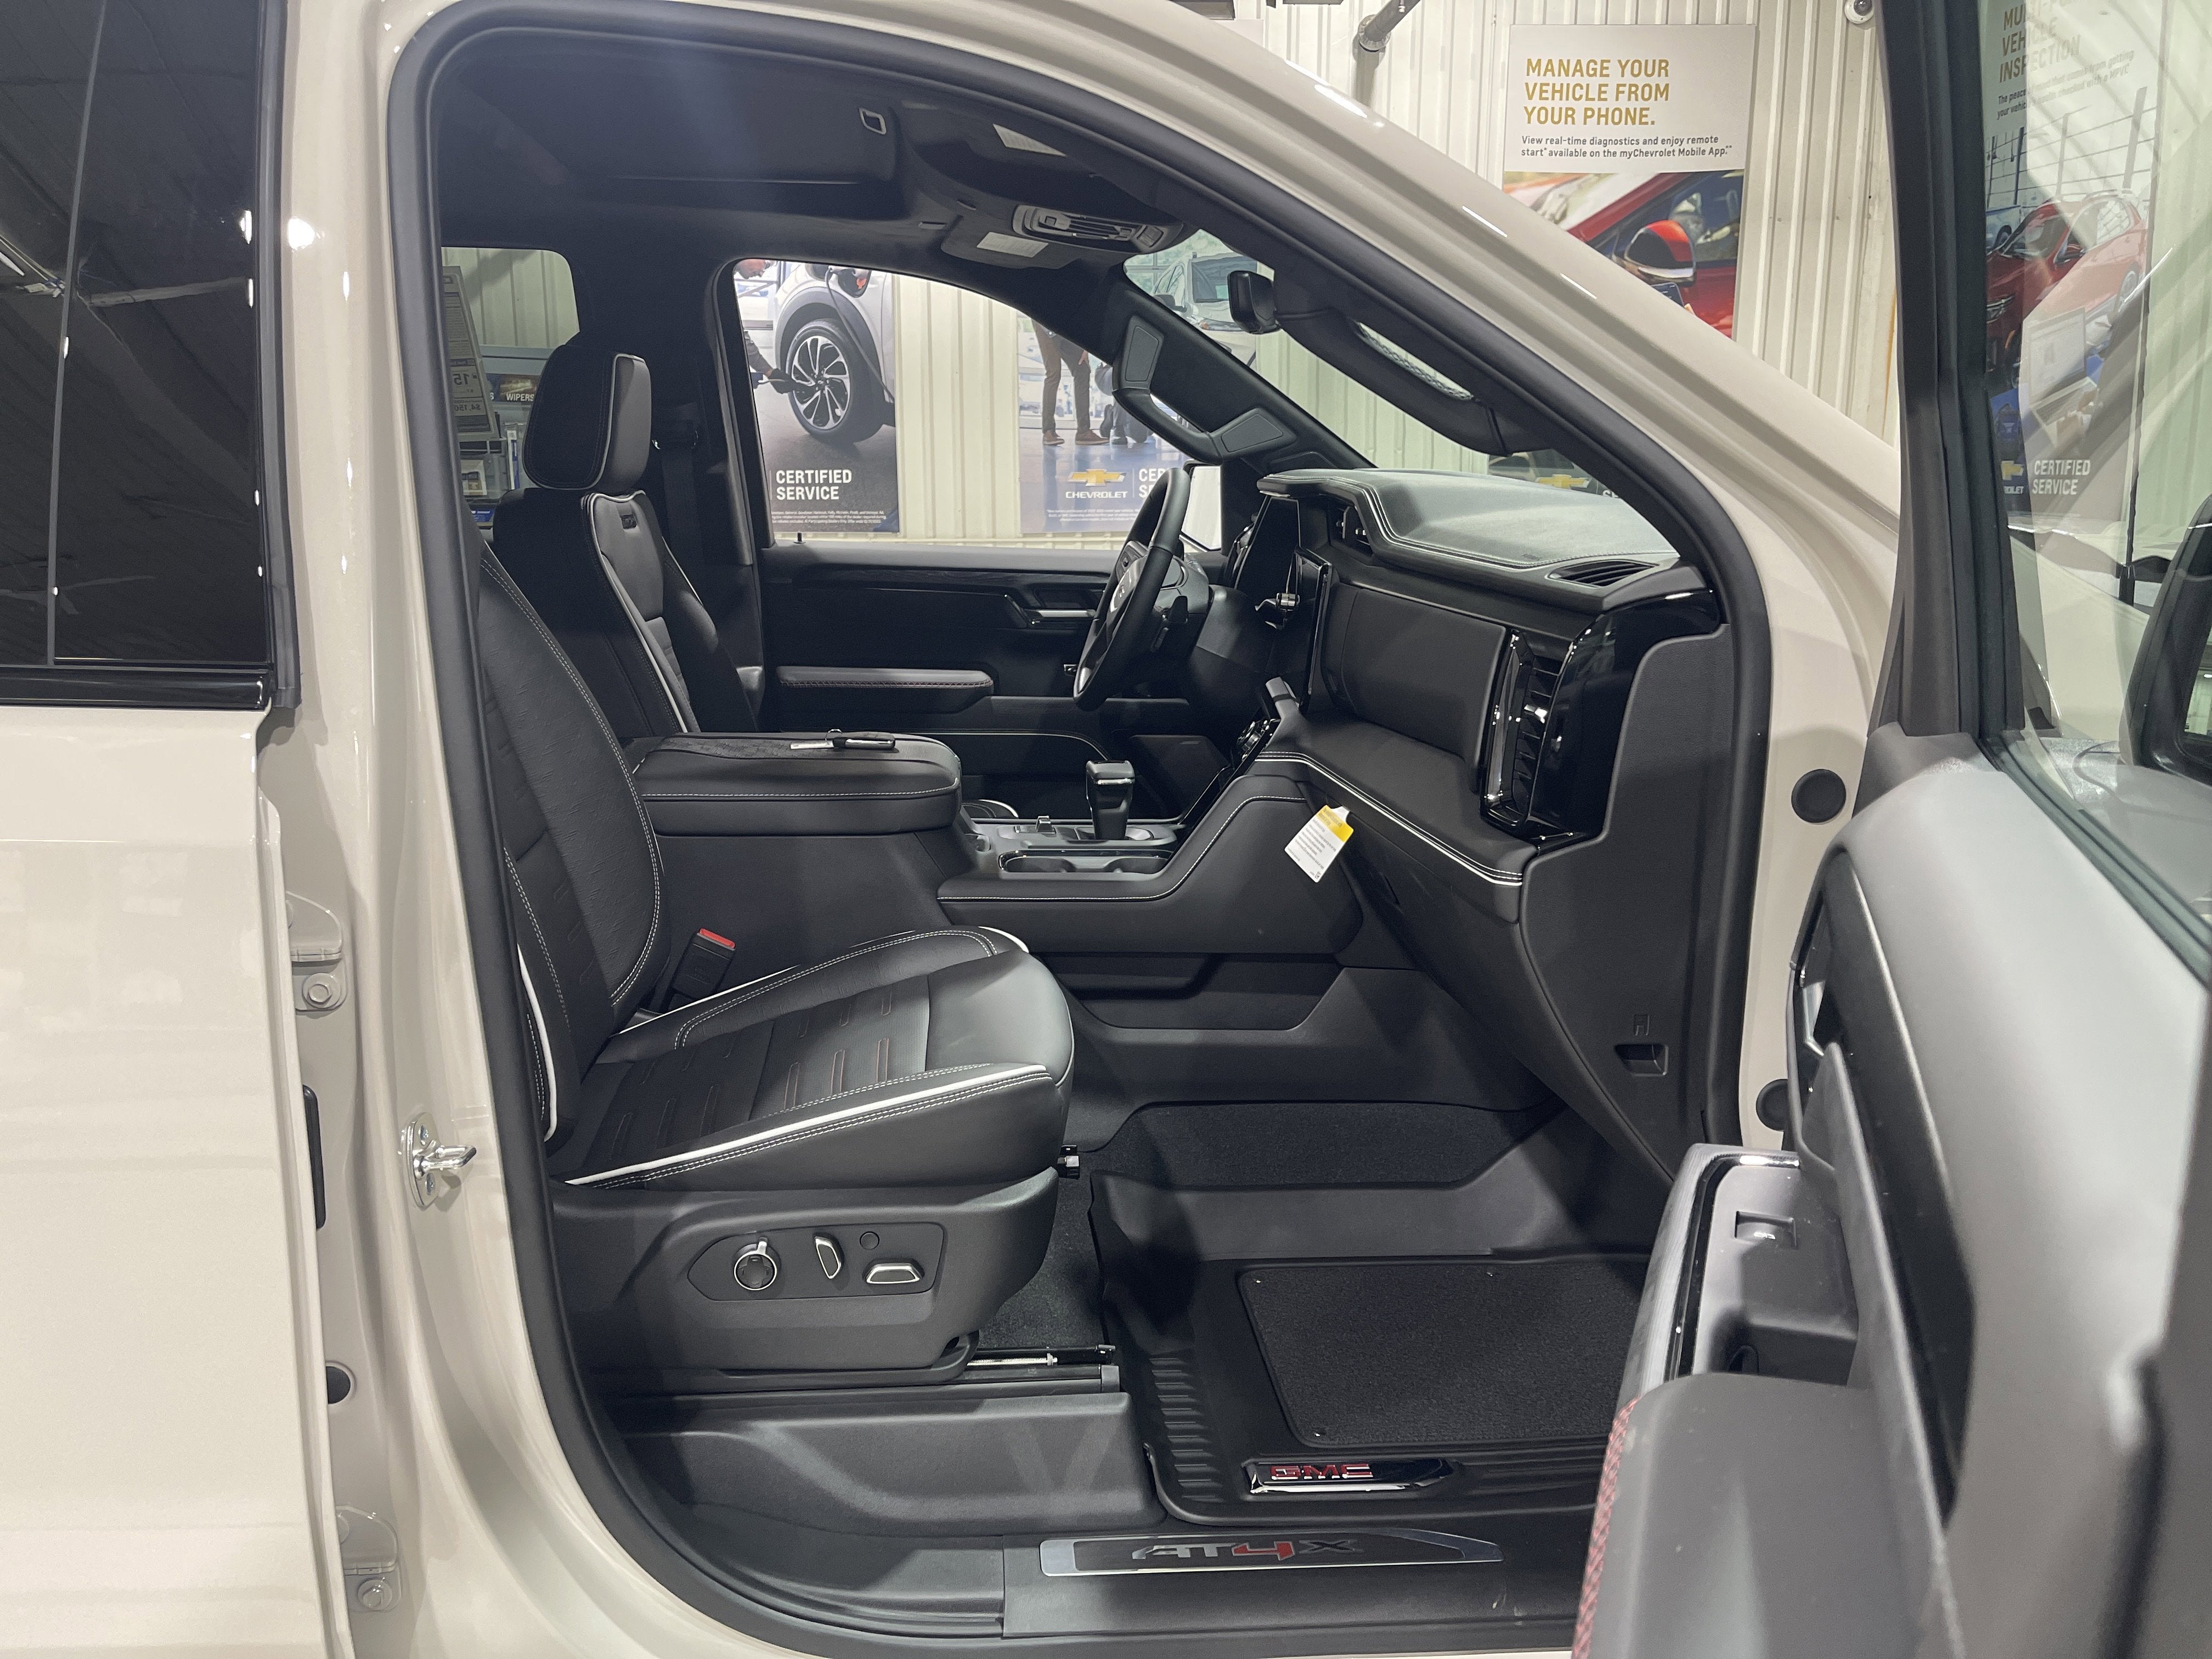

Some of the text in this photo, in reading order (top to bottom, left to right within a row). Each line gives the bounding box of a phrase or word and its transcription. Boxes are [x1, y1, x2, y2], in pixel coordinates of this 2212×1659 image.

[1526, 58, 1669, 78] MANAGE YOUR
[1525, 82, 1670, 102] VEHICLE FROM
[1523, 106, 1655, 126] YOUR PHONE.
[1522, 136, 1719, 148] View real-time diagnostics and enjoy remote
[1548, 148, 1587, 157] available
[1602, 149, 1617, 157] the
[1620, 148, 1675, 160] myChevrolet
[1678, 147, 1706, 157] Mobile
[506, 392, 534, 402] WIPERS
[2034, 459, 2091, 476] CERTIFIED
[776, 469, 853, 484] CERTIFIED
[776, 486, 840, 500] SERVICE
[1065, 490, 1128, 499] CHEVROLET
[2032, 478, 2079, 495] SERVICE
[1269, 1463, 1374, 1480] GMC
